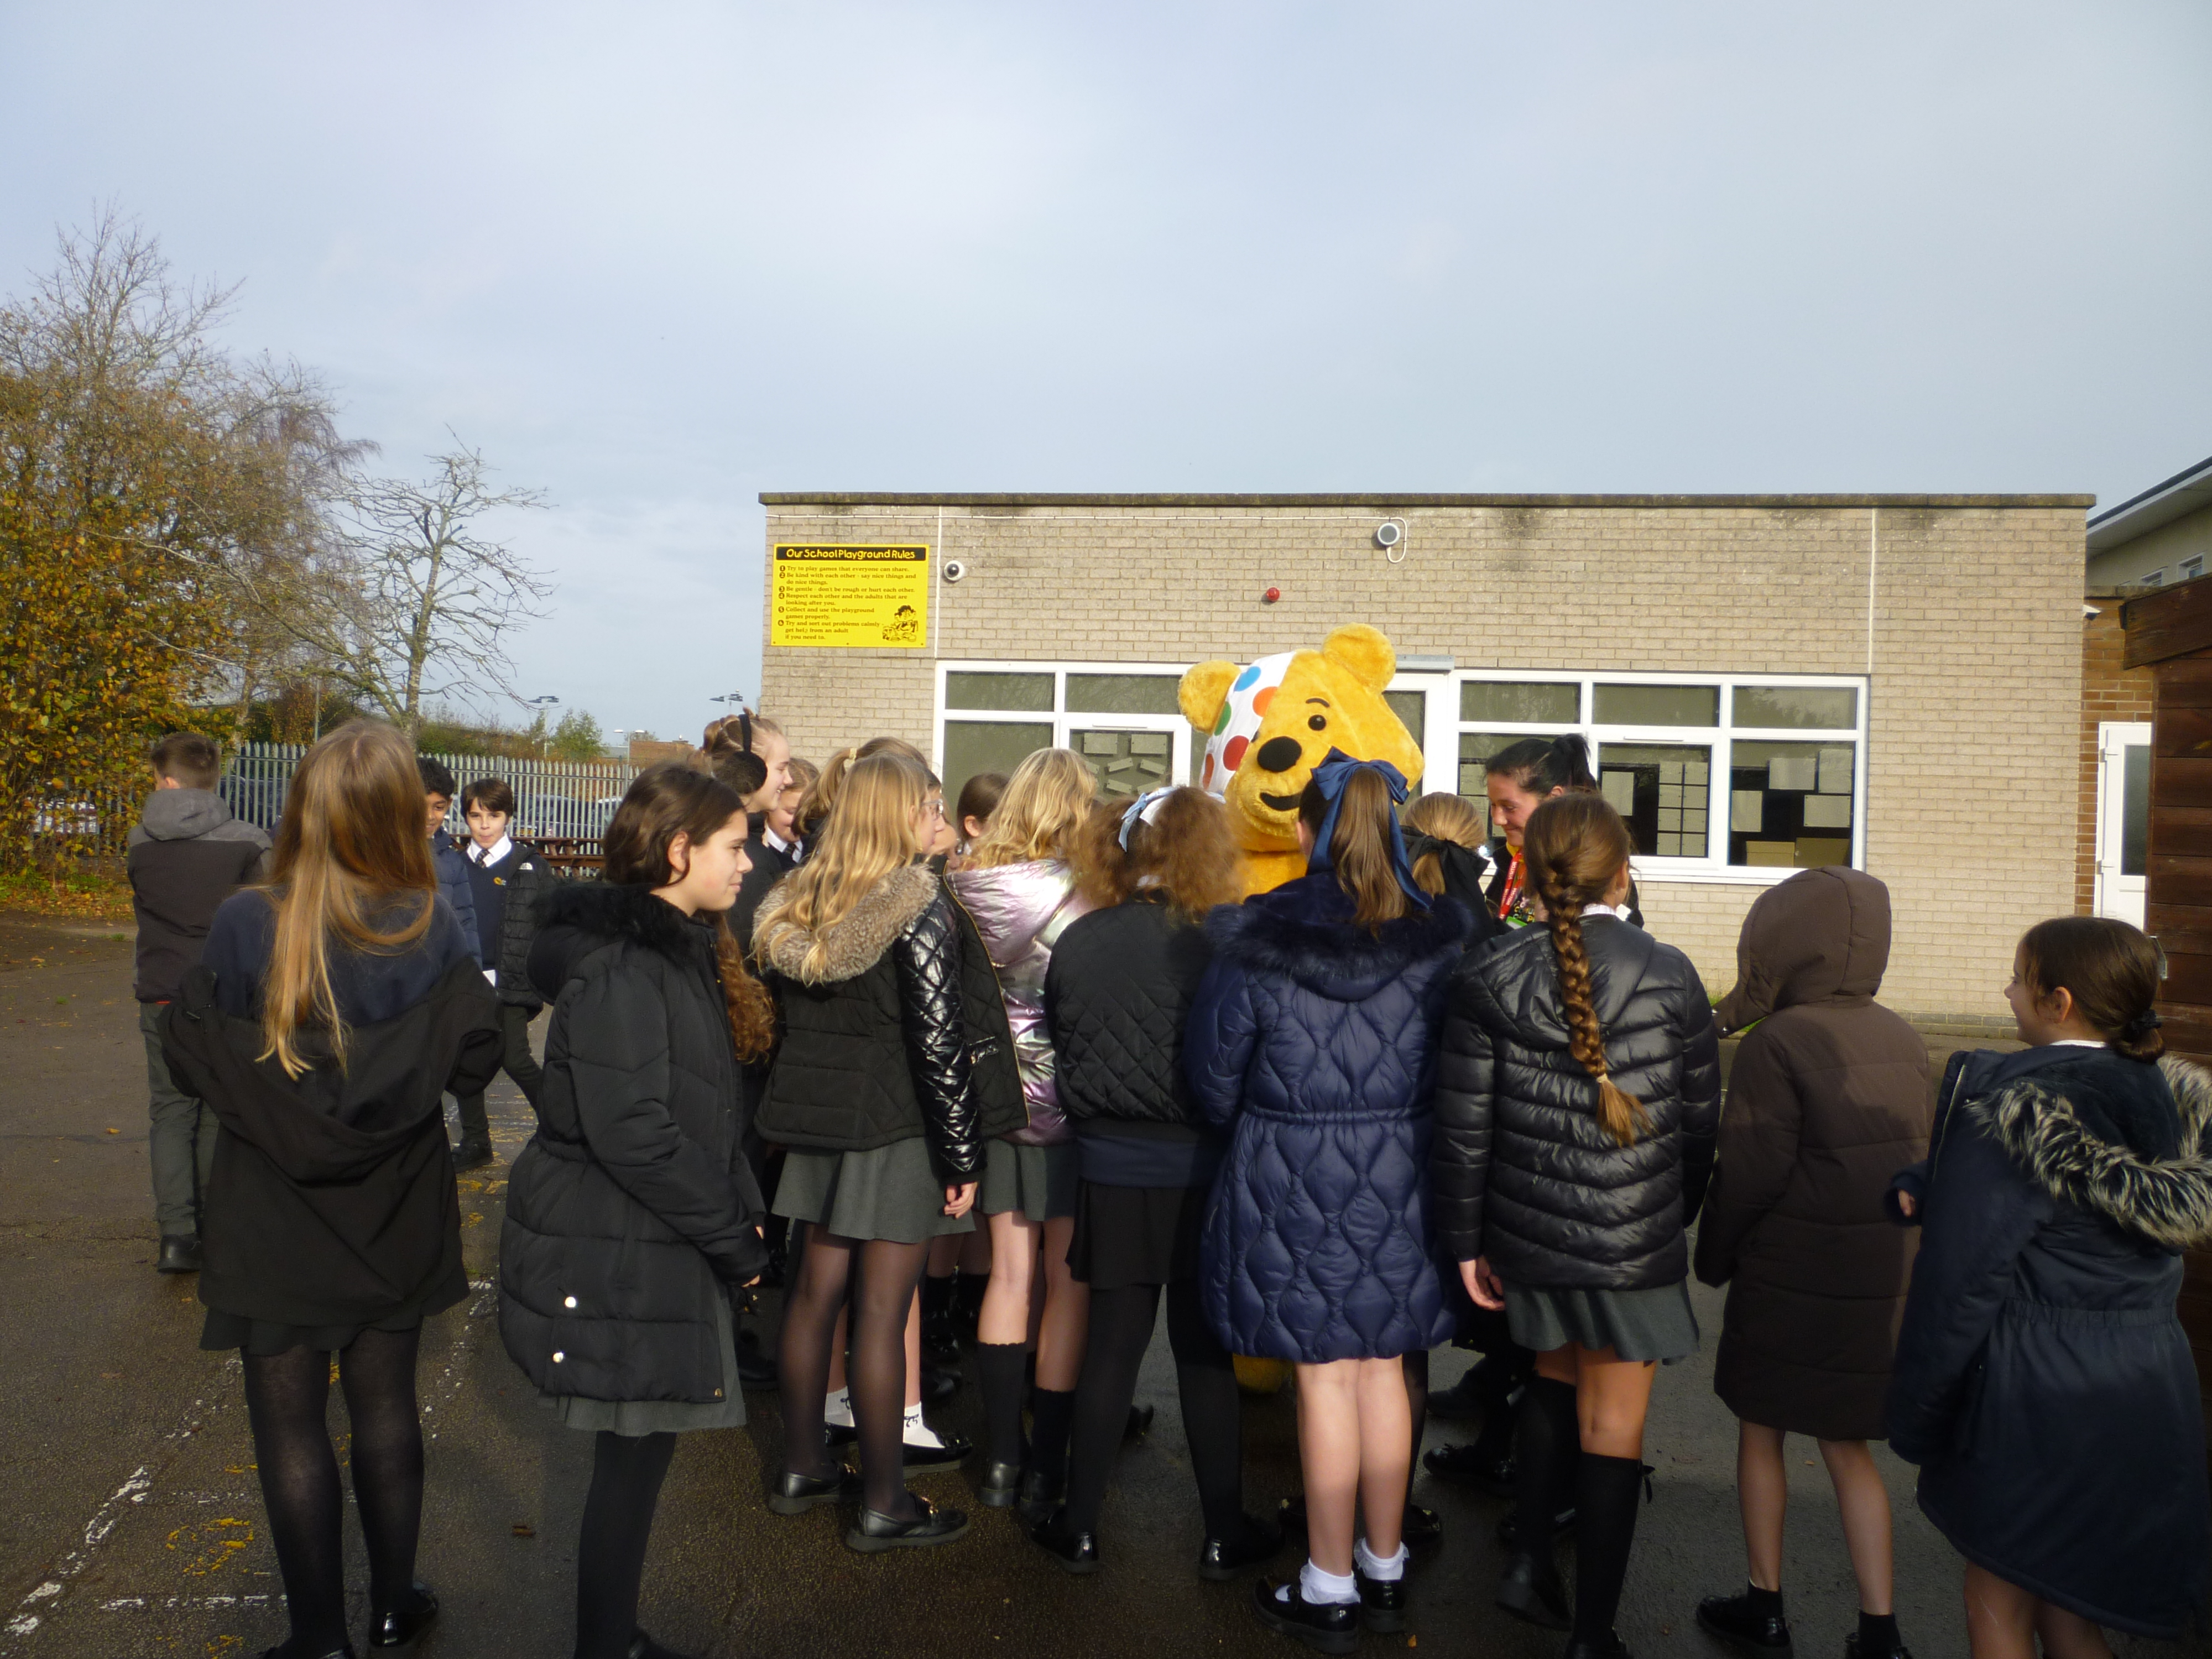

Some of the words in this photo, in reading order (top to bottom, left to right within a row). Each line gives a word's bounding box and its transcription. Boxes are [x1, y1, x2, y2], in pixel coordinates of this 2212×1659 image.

[786, 549, 803, 558] Our
[804, 549, 837, 558] School
[838, 549, 890, 560] Playground
[892, 550, 915, 559] Rules
[1508, 862, 1517, 880] VISITOR
